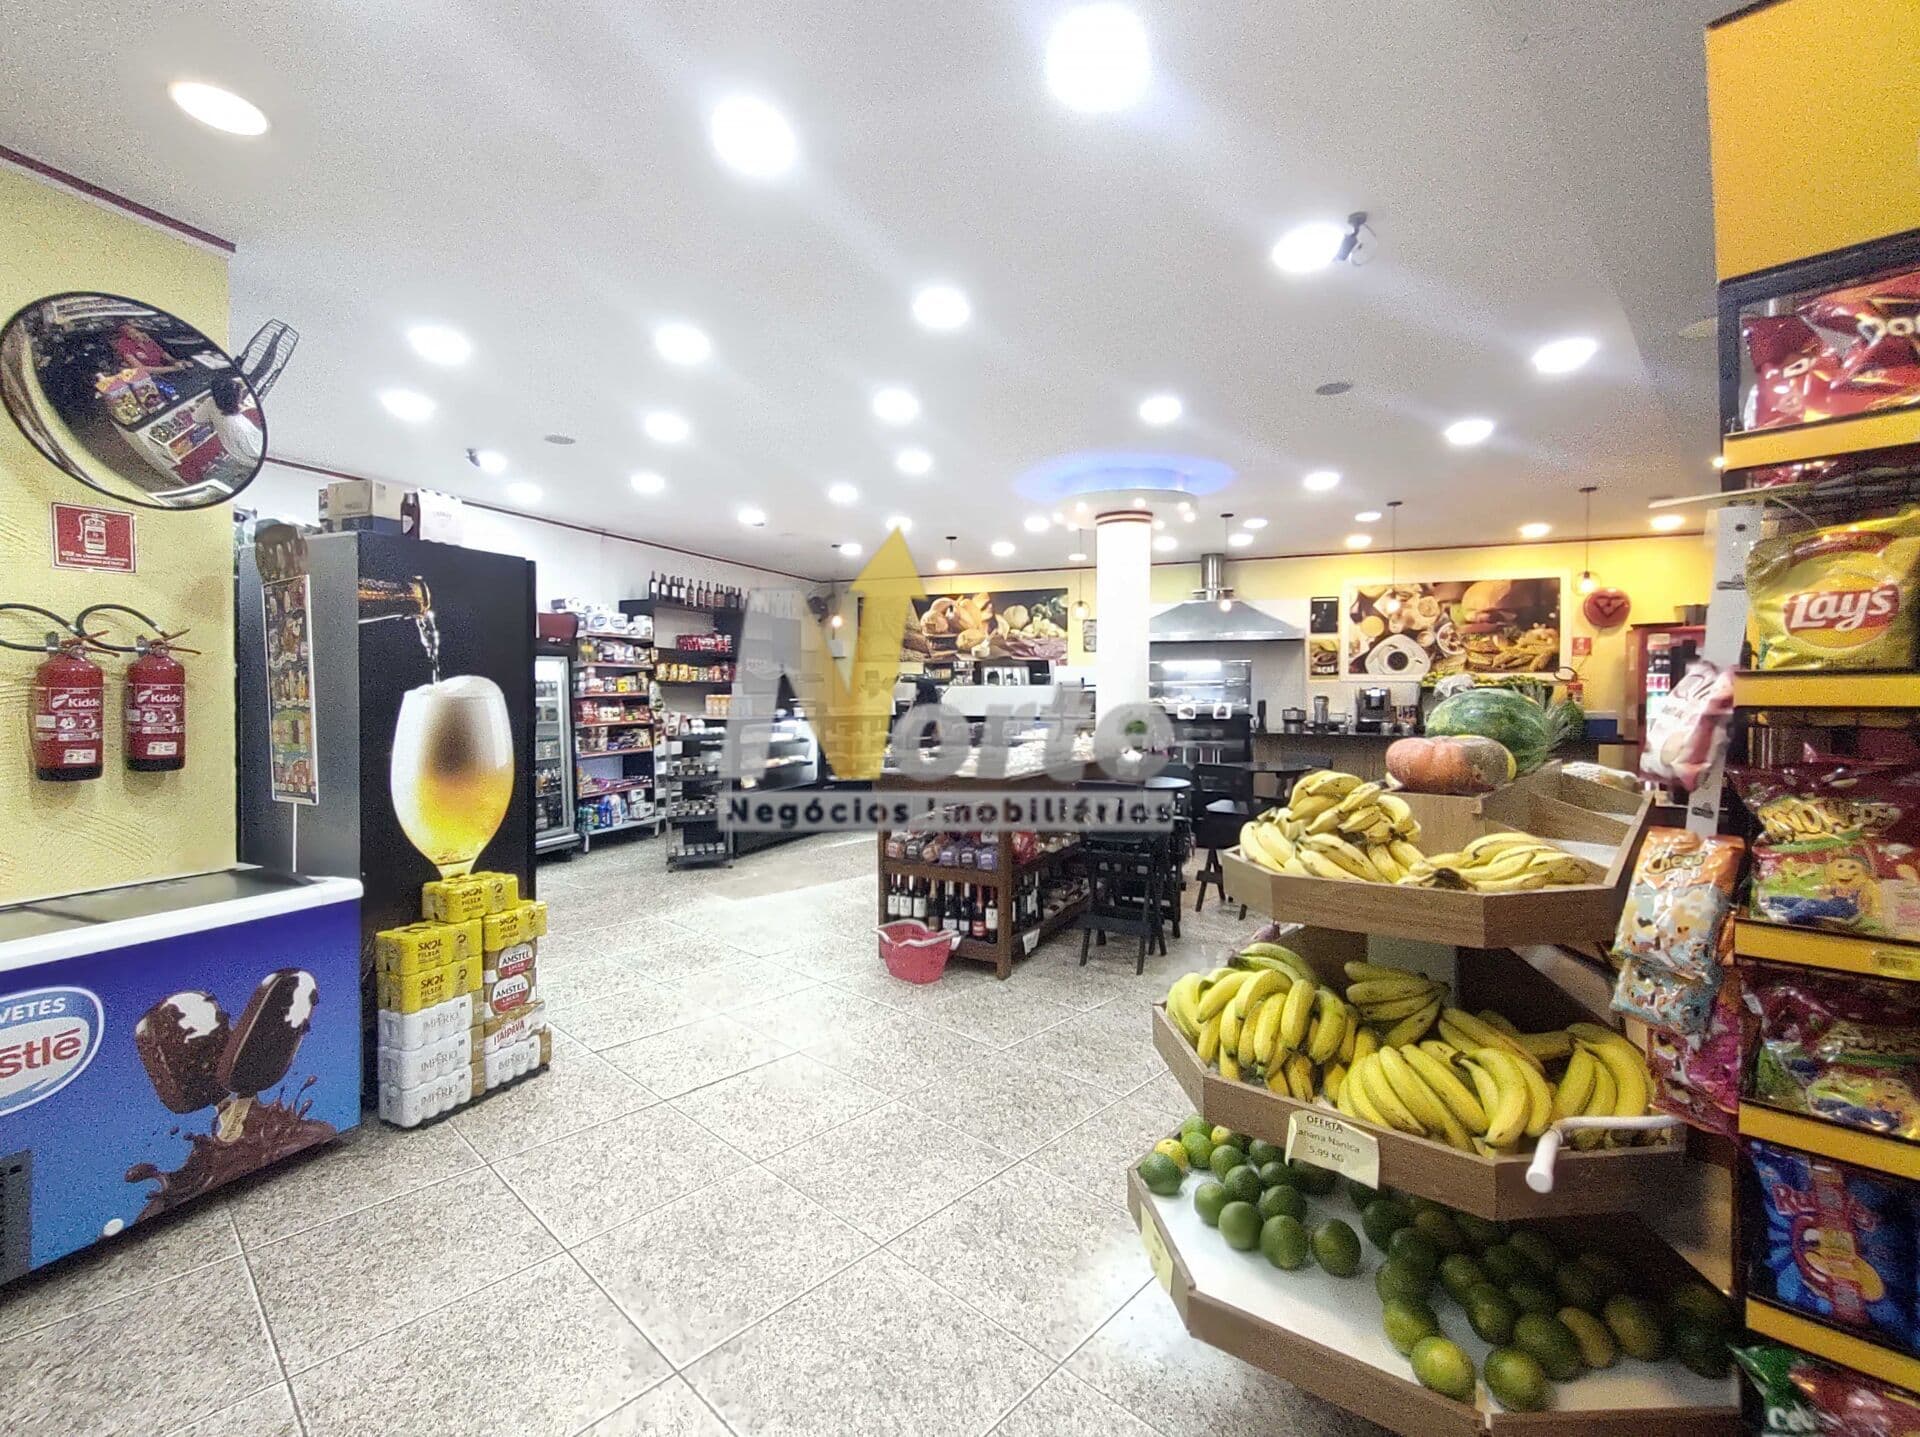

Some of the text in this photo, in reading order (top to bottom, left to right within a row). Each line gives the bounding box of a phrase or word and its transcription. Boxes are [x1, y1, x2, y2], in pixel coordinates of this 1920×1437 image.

[68, 697, 100, 708] Kidde
[150, 694, 181, 703] Kidde
[461, 886, 483, 899] SKOL
[500, 915, 519, 927] SKOL
[418, 938, 443, 950] SKOL
[501, 950, 530, 965] AMSTEL
[421, 974, 445, 988] SKOL
[495, 981, 525, 998] AMSTEL
[1306, 1115, 1344, 1133] OFERTA
